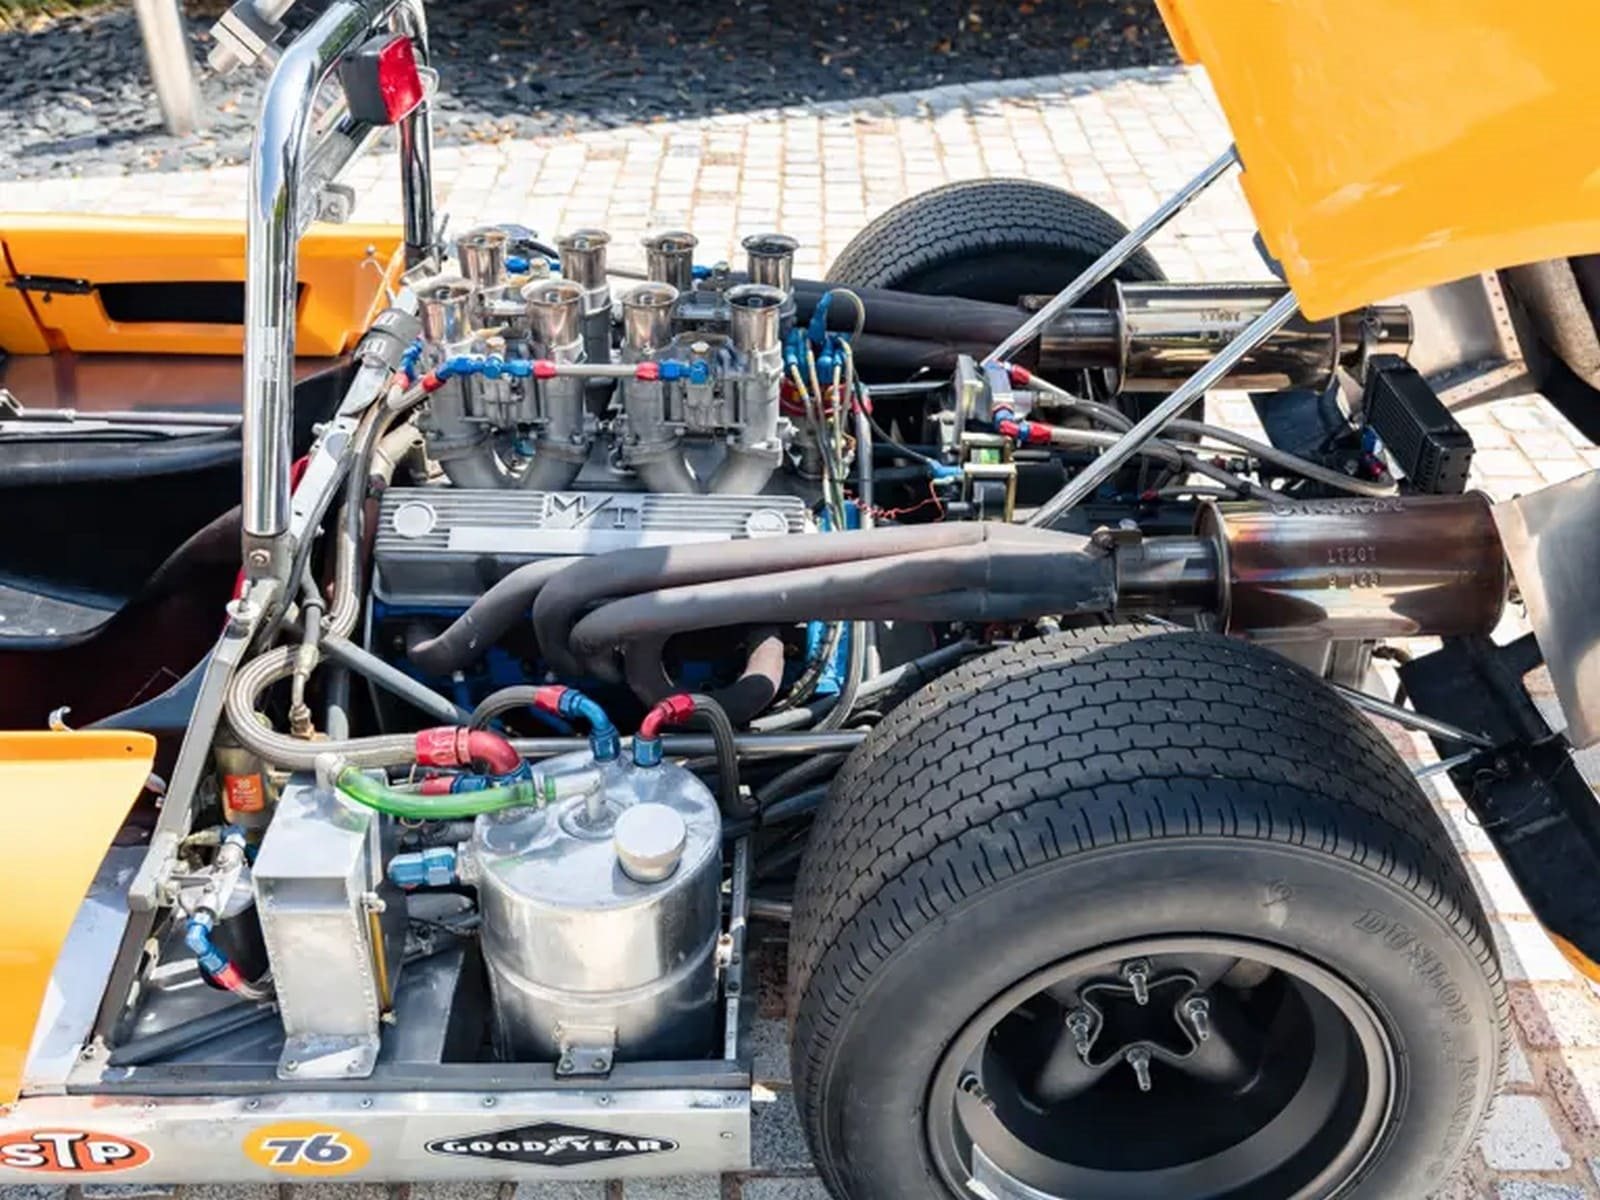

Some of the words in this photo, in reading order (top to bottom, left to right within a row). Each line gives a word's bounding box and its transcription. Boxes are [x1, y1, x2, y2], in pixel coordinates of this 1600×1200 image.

[1352, 908, 1472, 1025] DUNLOP
[0, 1132, 135, 1169] STP
[261, 1133, 351, 1164] 76
